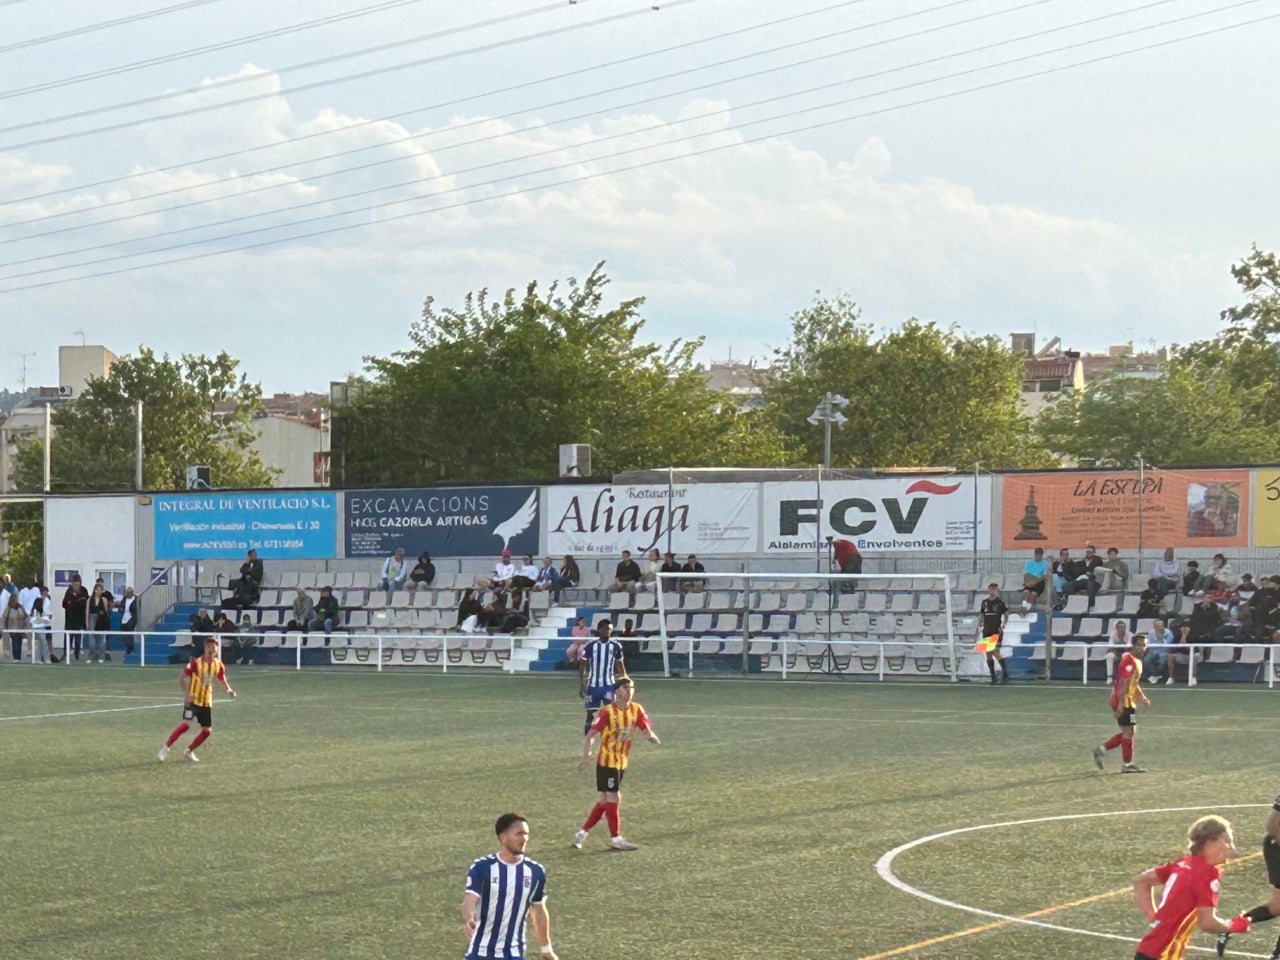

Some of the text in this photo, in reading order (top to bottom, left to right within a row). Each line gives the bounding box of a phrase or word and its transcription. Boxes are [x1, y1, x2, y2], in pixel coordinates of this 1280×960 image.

[1073, 479, 1097, 496] LA
[159, 500, 215, 512] INTEGRAL
[219, 499, 233, 510] DE
[351, 495, 489, 514] EXCAVACIONS
[379, 517, 432, 527] CAZORLA
[436, 515, 488, 526] ARTIGAS
[551, 488, 689, 555] Aliaga
[780, 498, 929, 536] FCV
